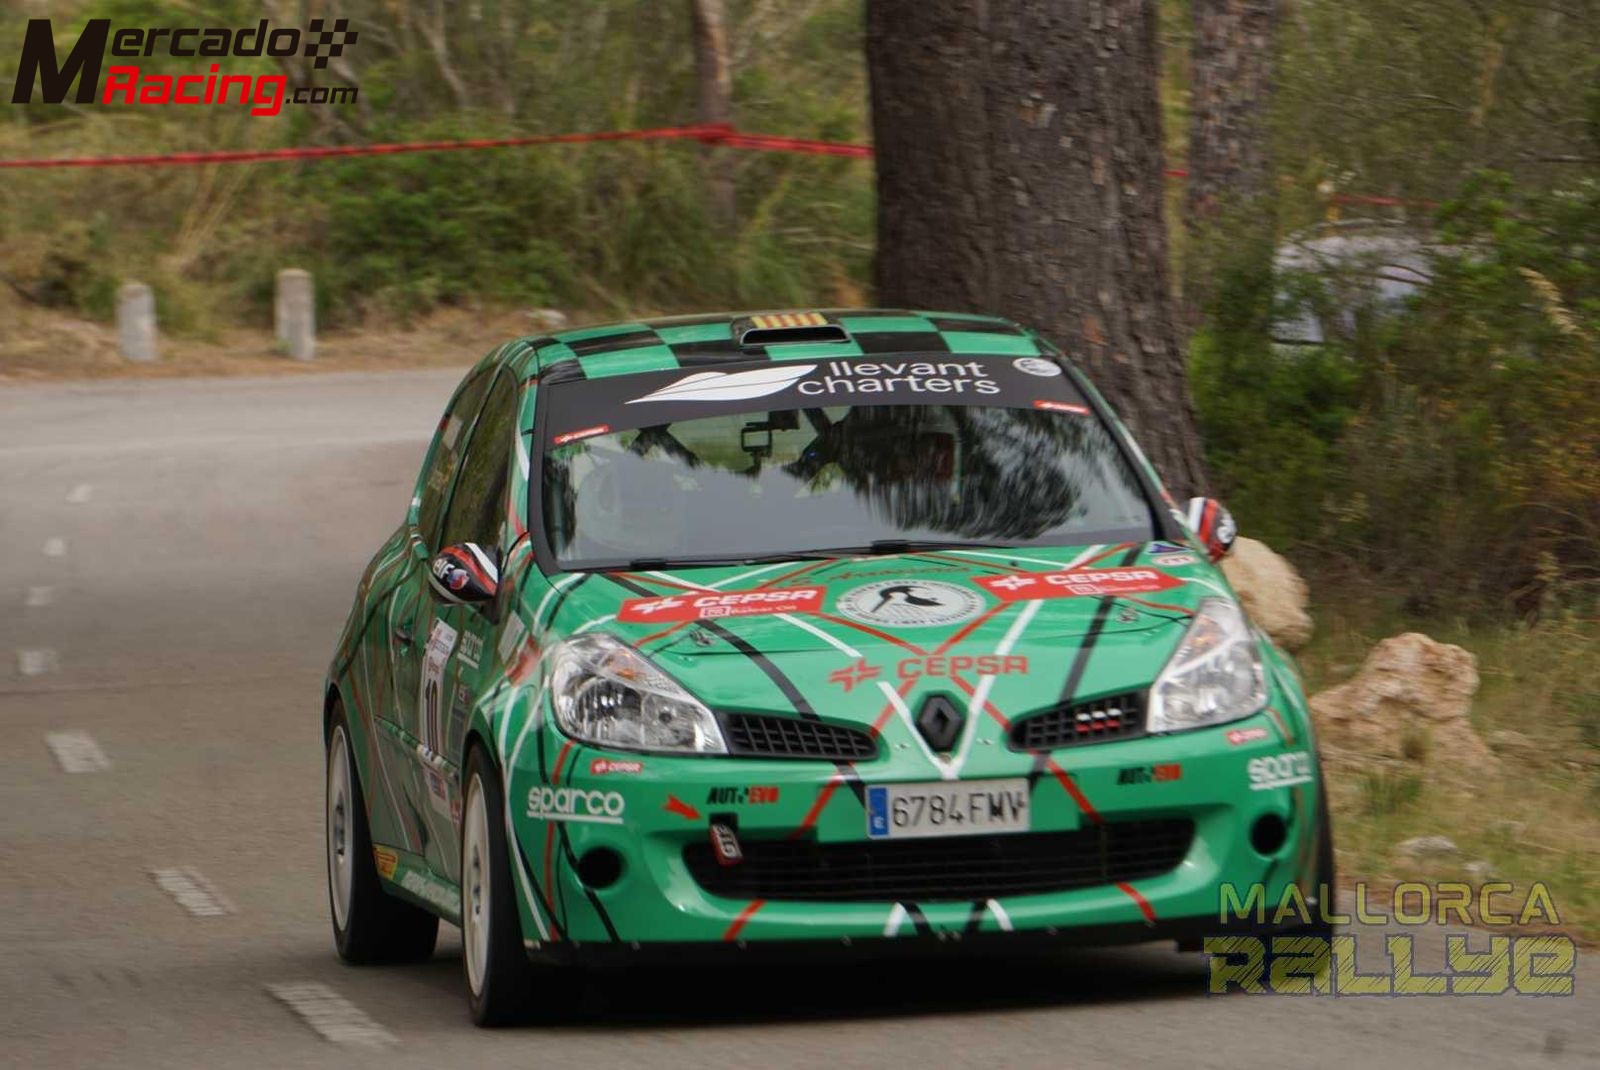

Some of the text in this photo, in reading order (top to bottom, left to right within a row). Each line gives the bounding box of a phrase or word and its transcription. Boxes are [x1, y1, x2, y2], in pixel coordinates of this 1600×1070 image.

[829, 361, 988, 378] llevant
[797, 374, 1001, 396] charters
[1045, 570, 1160, 586] CEPSA
[693, 589, 818, 608] CEPSA
[896, 655, 1029, 680] CEPSA
[528, 786, 625, 819] sparco
